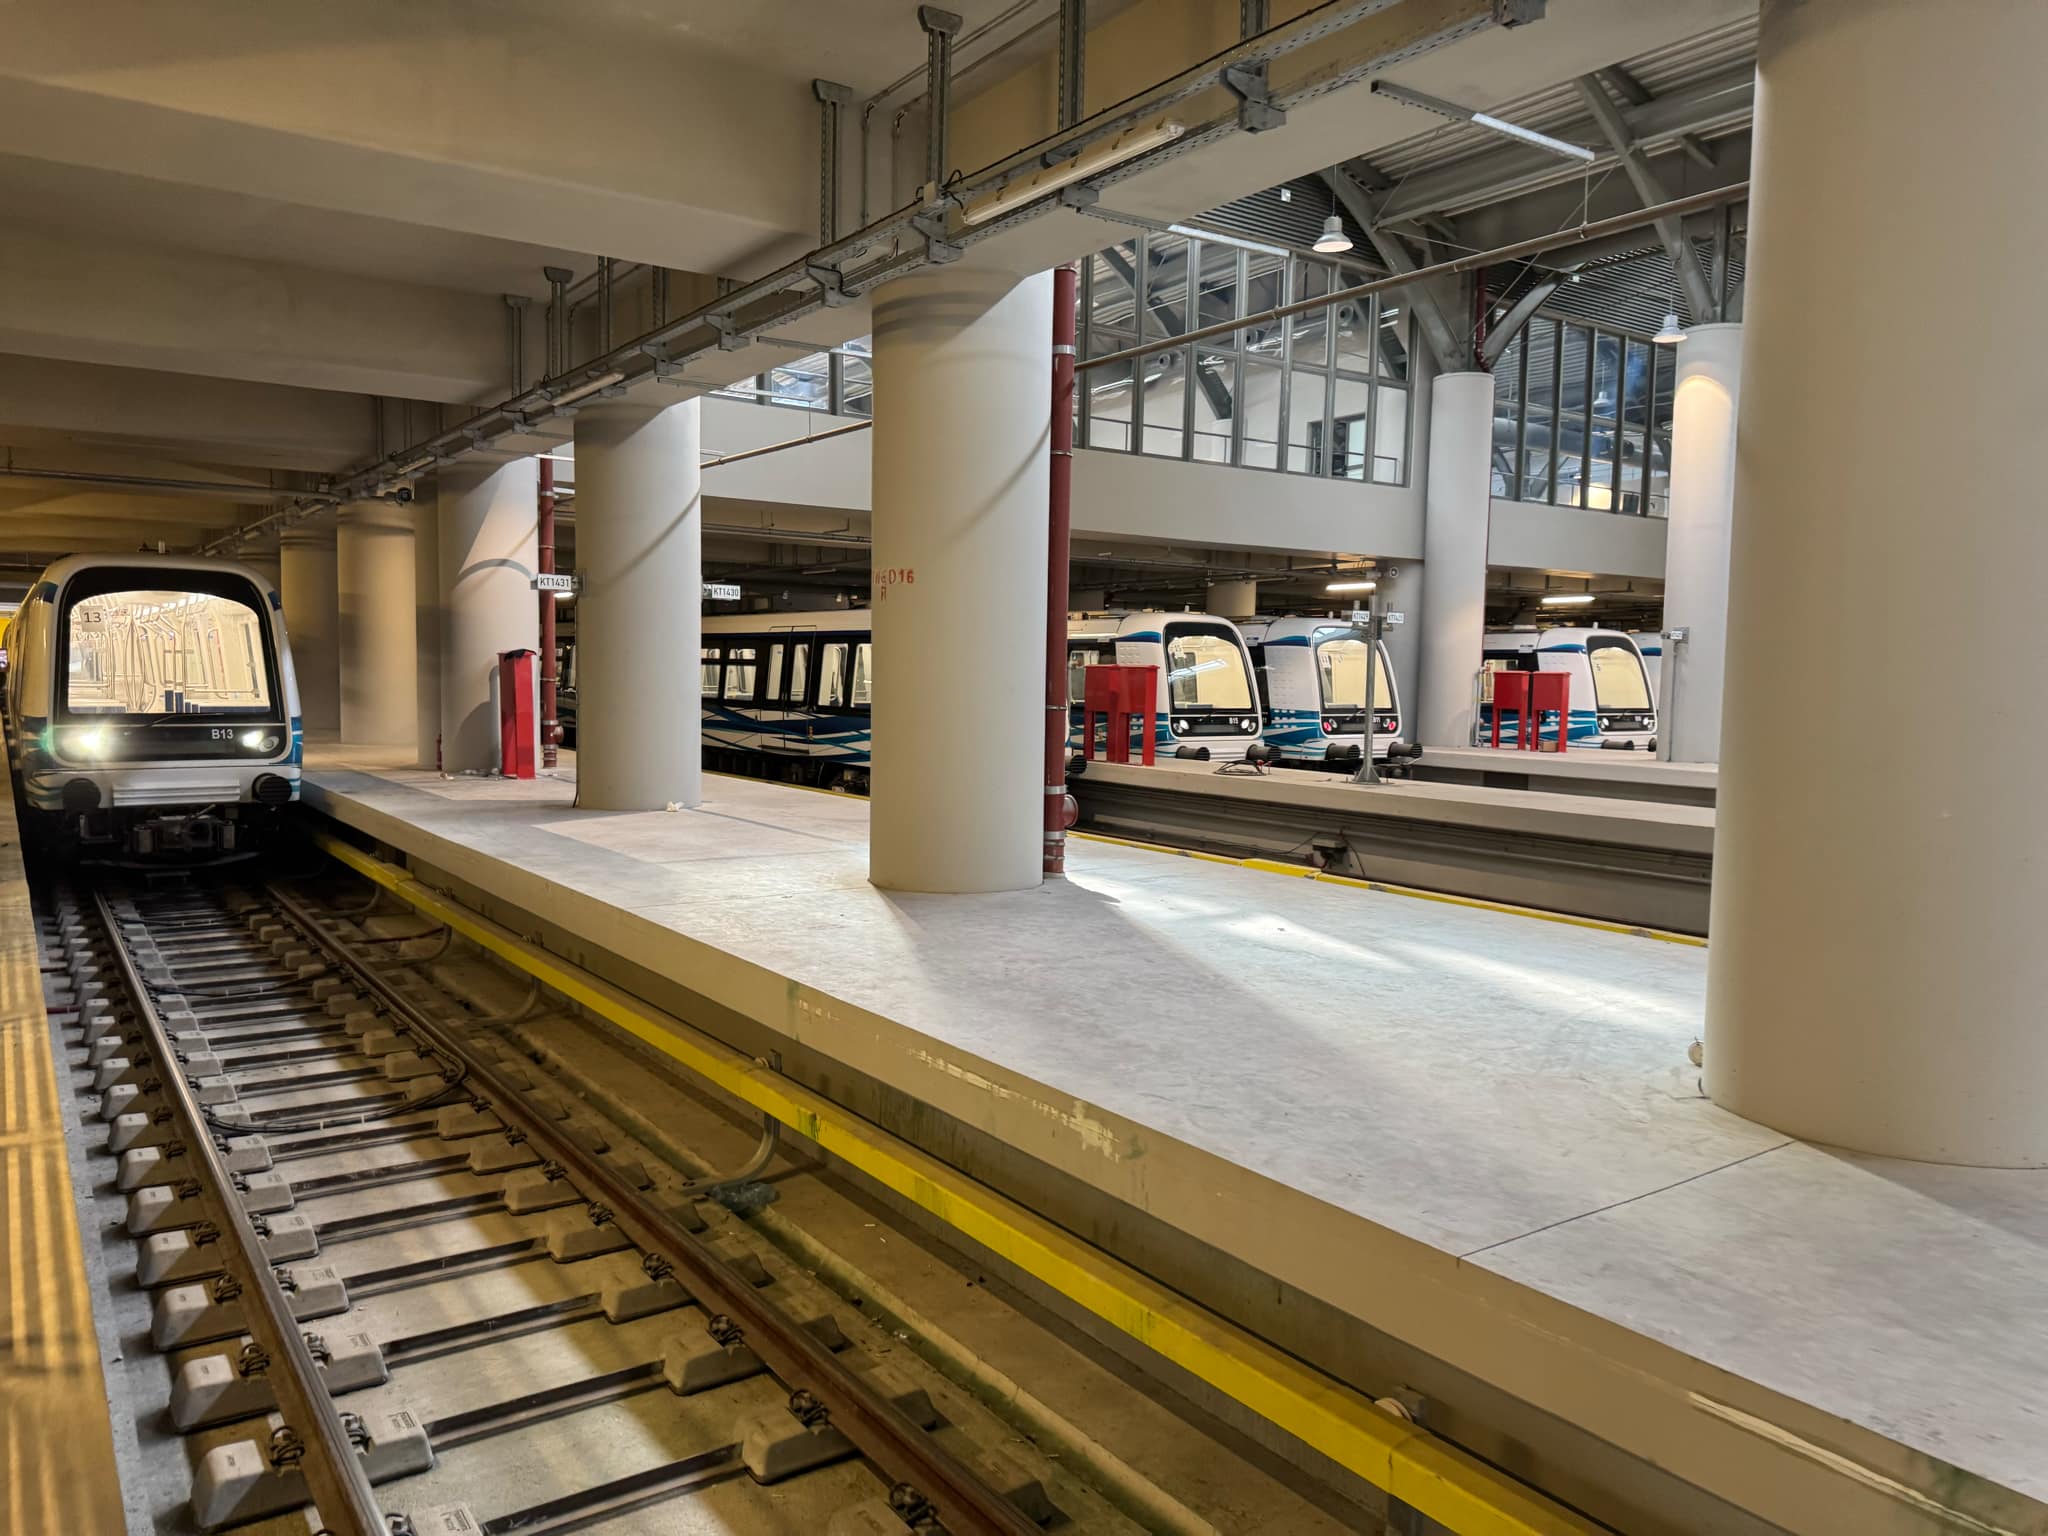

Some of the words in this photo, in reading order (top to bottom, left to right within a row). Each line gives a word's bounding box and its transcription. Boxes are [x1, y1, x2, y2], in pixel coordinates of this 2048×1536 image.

[540, 576, 569, 587] KT1431
[713, 587, 739, 597] KT1430
[83, 612, 102, 623] 13
[212, 729, 234, 739] B13
